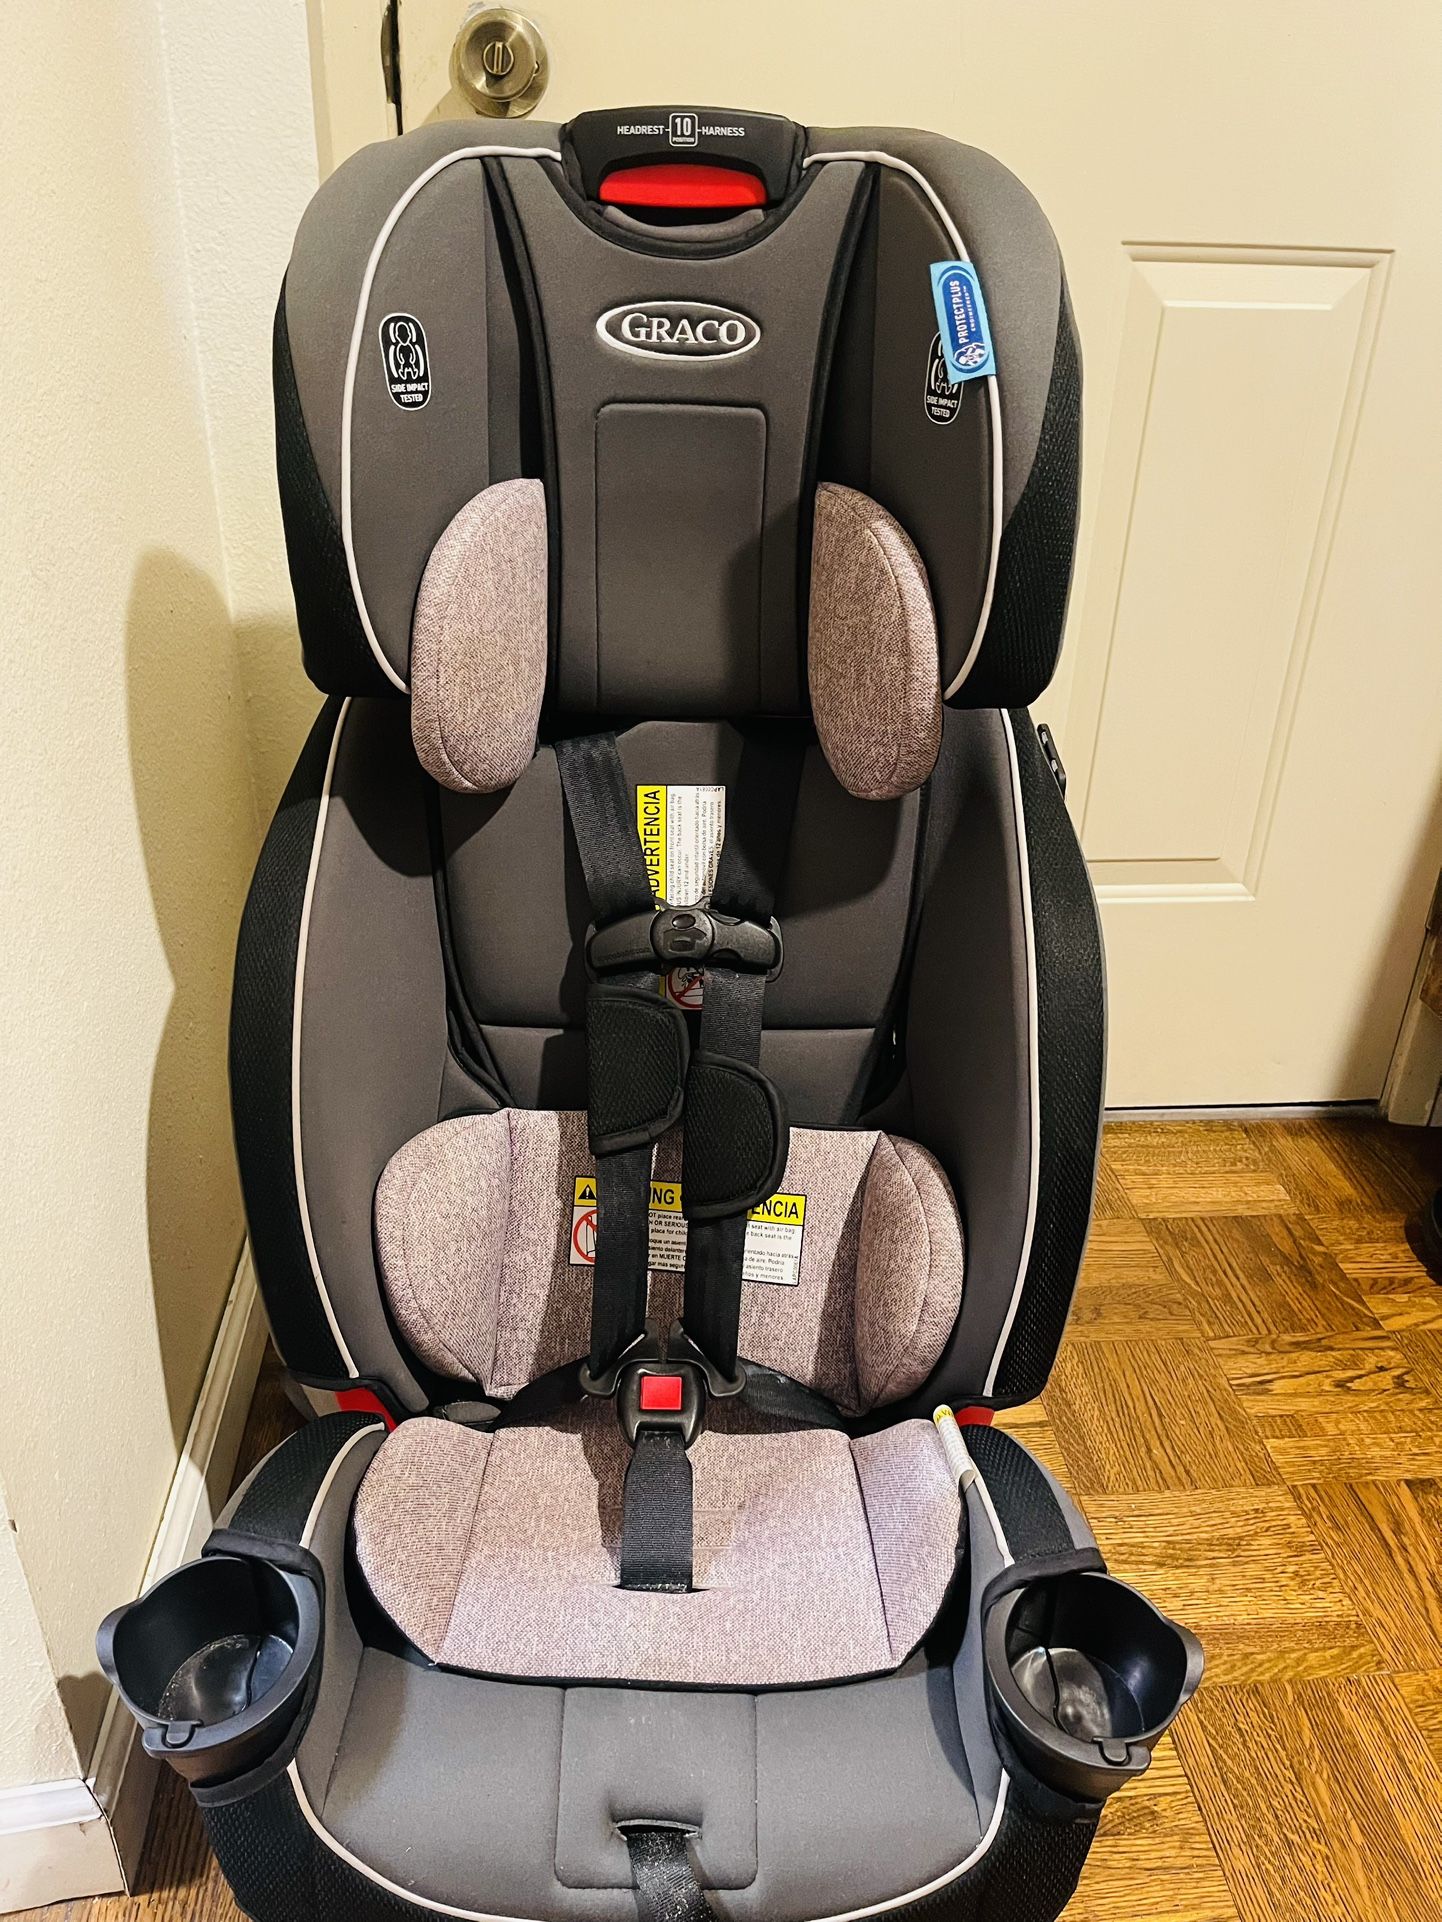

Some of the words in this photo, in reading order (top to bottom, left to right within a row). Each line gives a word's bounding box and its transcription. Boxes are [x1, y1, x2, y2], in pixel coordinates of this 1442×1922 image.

[617, 125, 665, 135] HEADREST
[675, 117, 692, 136] 10
[701, 126, 745, 137] HARNESS
[950, 280, 970, 344] PROTECTPLUS
[621, 312, 746, 346] GRACO
[391, 384, 406, 393] SIDE
[406, 382, 428, 392] IMPACT
[400, 394, 423, 402] TESTED
[926, 395, 938, 404] SIDE
[938, 396, 958, 408] IMPACT
[931, 406, 951, 418] TESTED
[652, 1187, 675, 1205] NG
[752, 1200, 799, 1219] ENCIA
[658, 1212, 671, 1220] place
[651, 1227, 665, 1235] place
